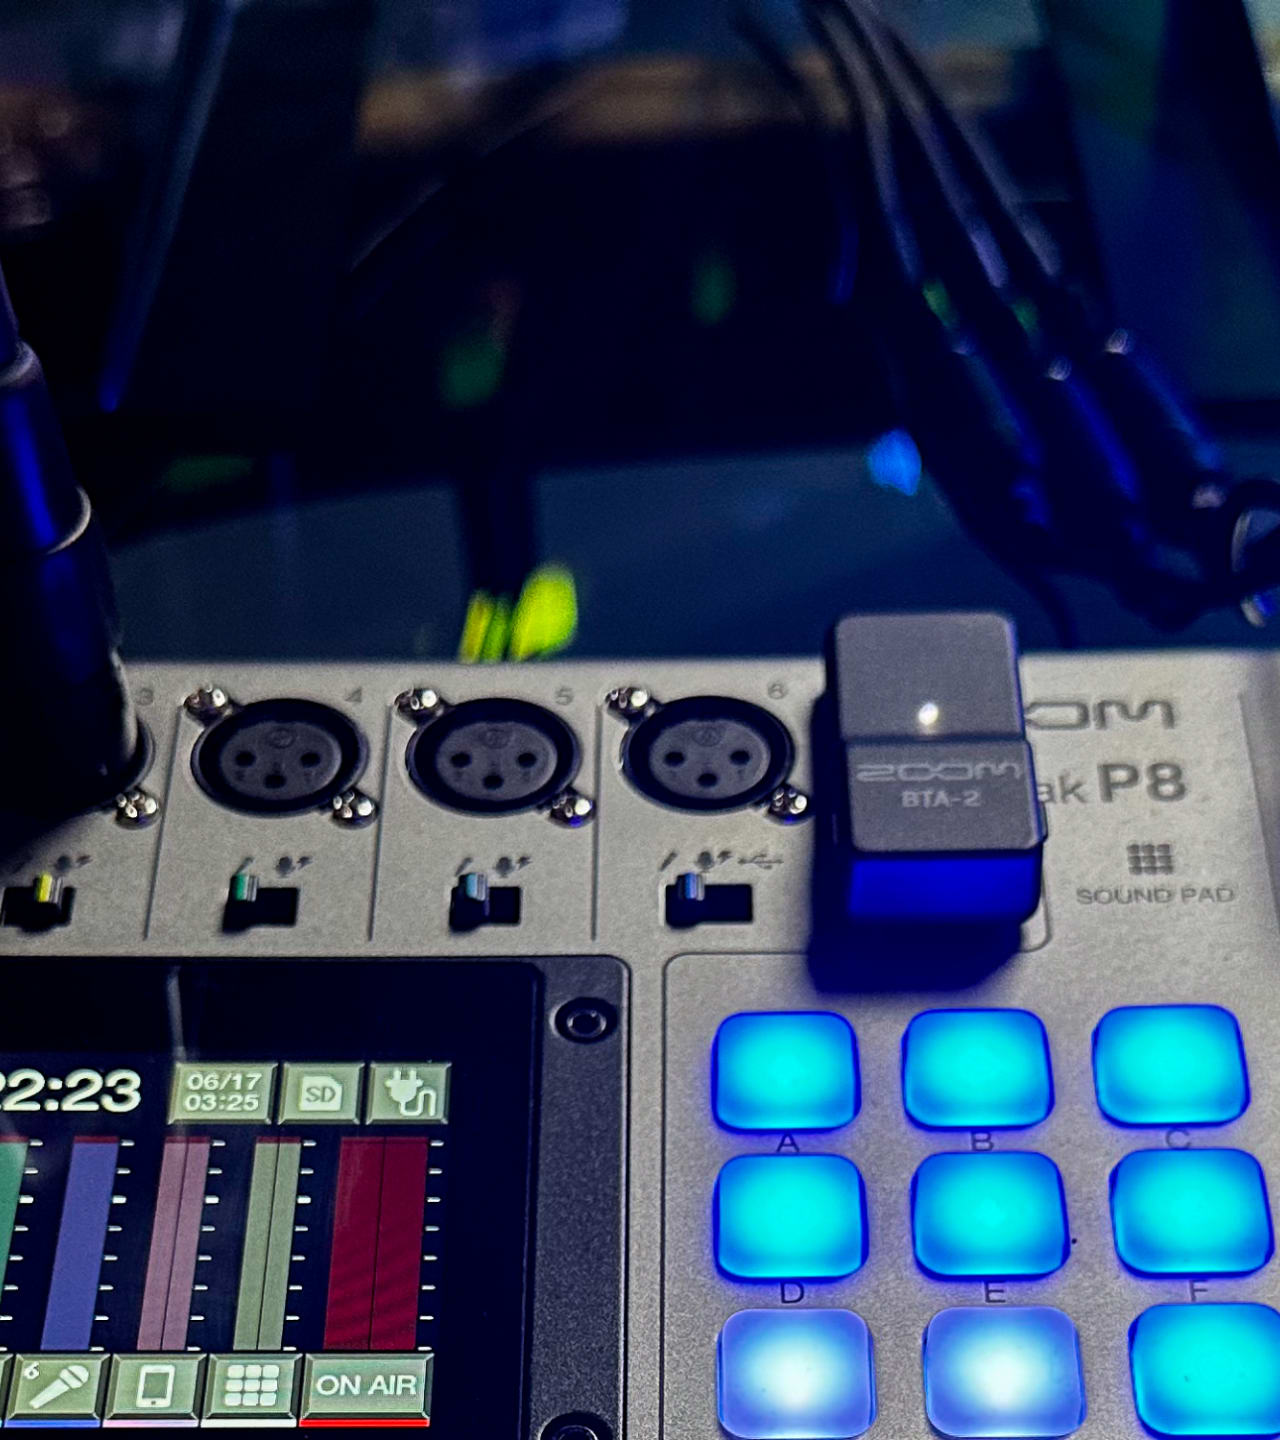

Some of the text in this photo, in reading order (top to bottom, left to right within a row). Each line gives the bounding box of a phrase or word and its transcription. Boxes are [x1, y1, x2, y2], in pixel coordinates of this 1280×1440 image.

[344, 686, 362, 703] 4
[556, 686, 574, 705] 5
[767, 682, 789, 700] 6
[855, 763, 1020, 782] ZOOM
[1096, 762, 1187, 802] P8
[901, 790, 982, 808] BTA-2
[1076, 886, 1234, 905] SOUND PAD
[186, 1071, 263, 1092] 06/17
[183, 1093, 260, 1112] 03:25
[305, 1086, 337, 1103] SD
[776, 1132, 801, 1153] A
[970, 1131, 994, 1152] B
[1164, 1128, 1191, 1150] C
[779, 1281, 806, 1304] D
[983, 1281, 1007, 1304] E
[1188, 1279, 1209, 1302] F
[23, 1361, 41, 1380] 6
[316, 1373, 418, 1397] ON AIR
